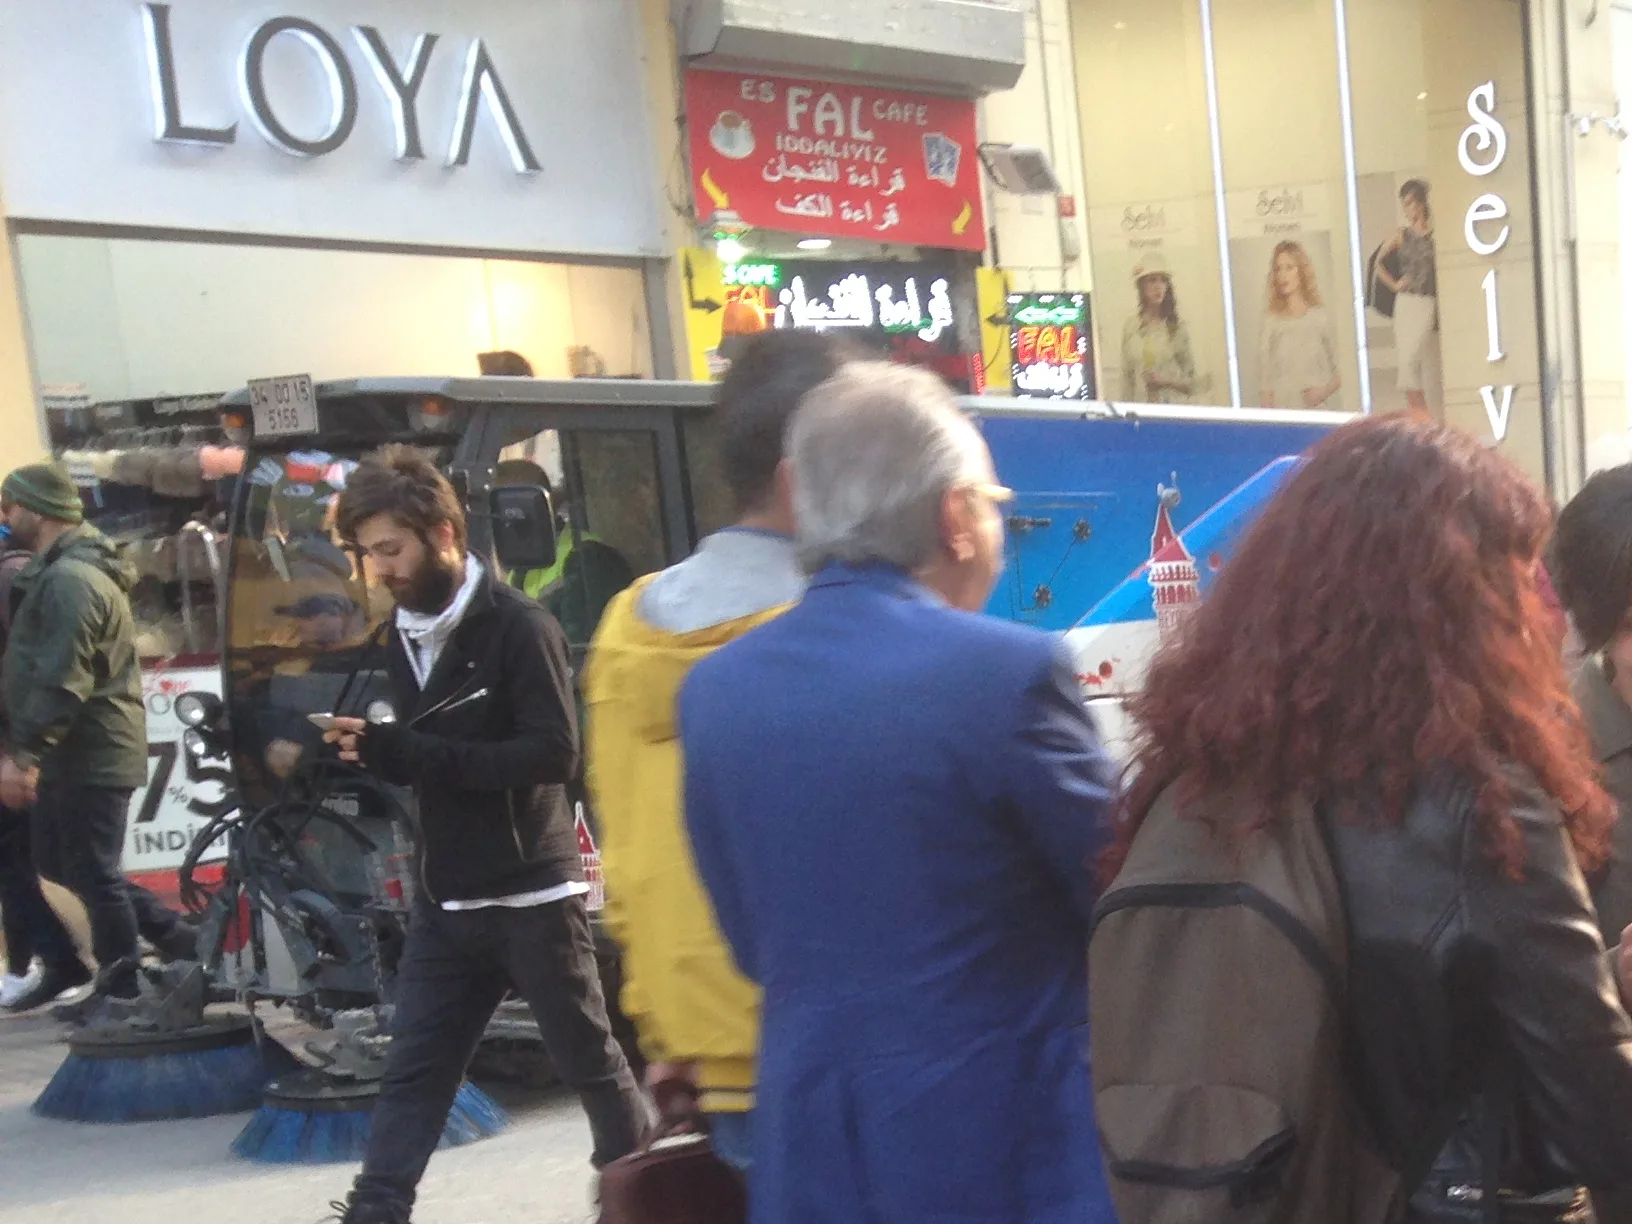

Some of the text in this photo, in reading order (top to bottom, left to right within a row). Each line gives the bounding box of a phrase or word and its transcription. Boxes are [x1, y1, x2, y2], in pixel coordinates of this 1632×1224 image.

[140, 2, 544, 174] LOYA
[786, 86, 875, 142] FAL
[872, 99, 929, 126] CAFE
[1457, 80, 1514, 441] Selv
[1017, 326, 1084, 366] FAL
